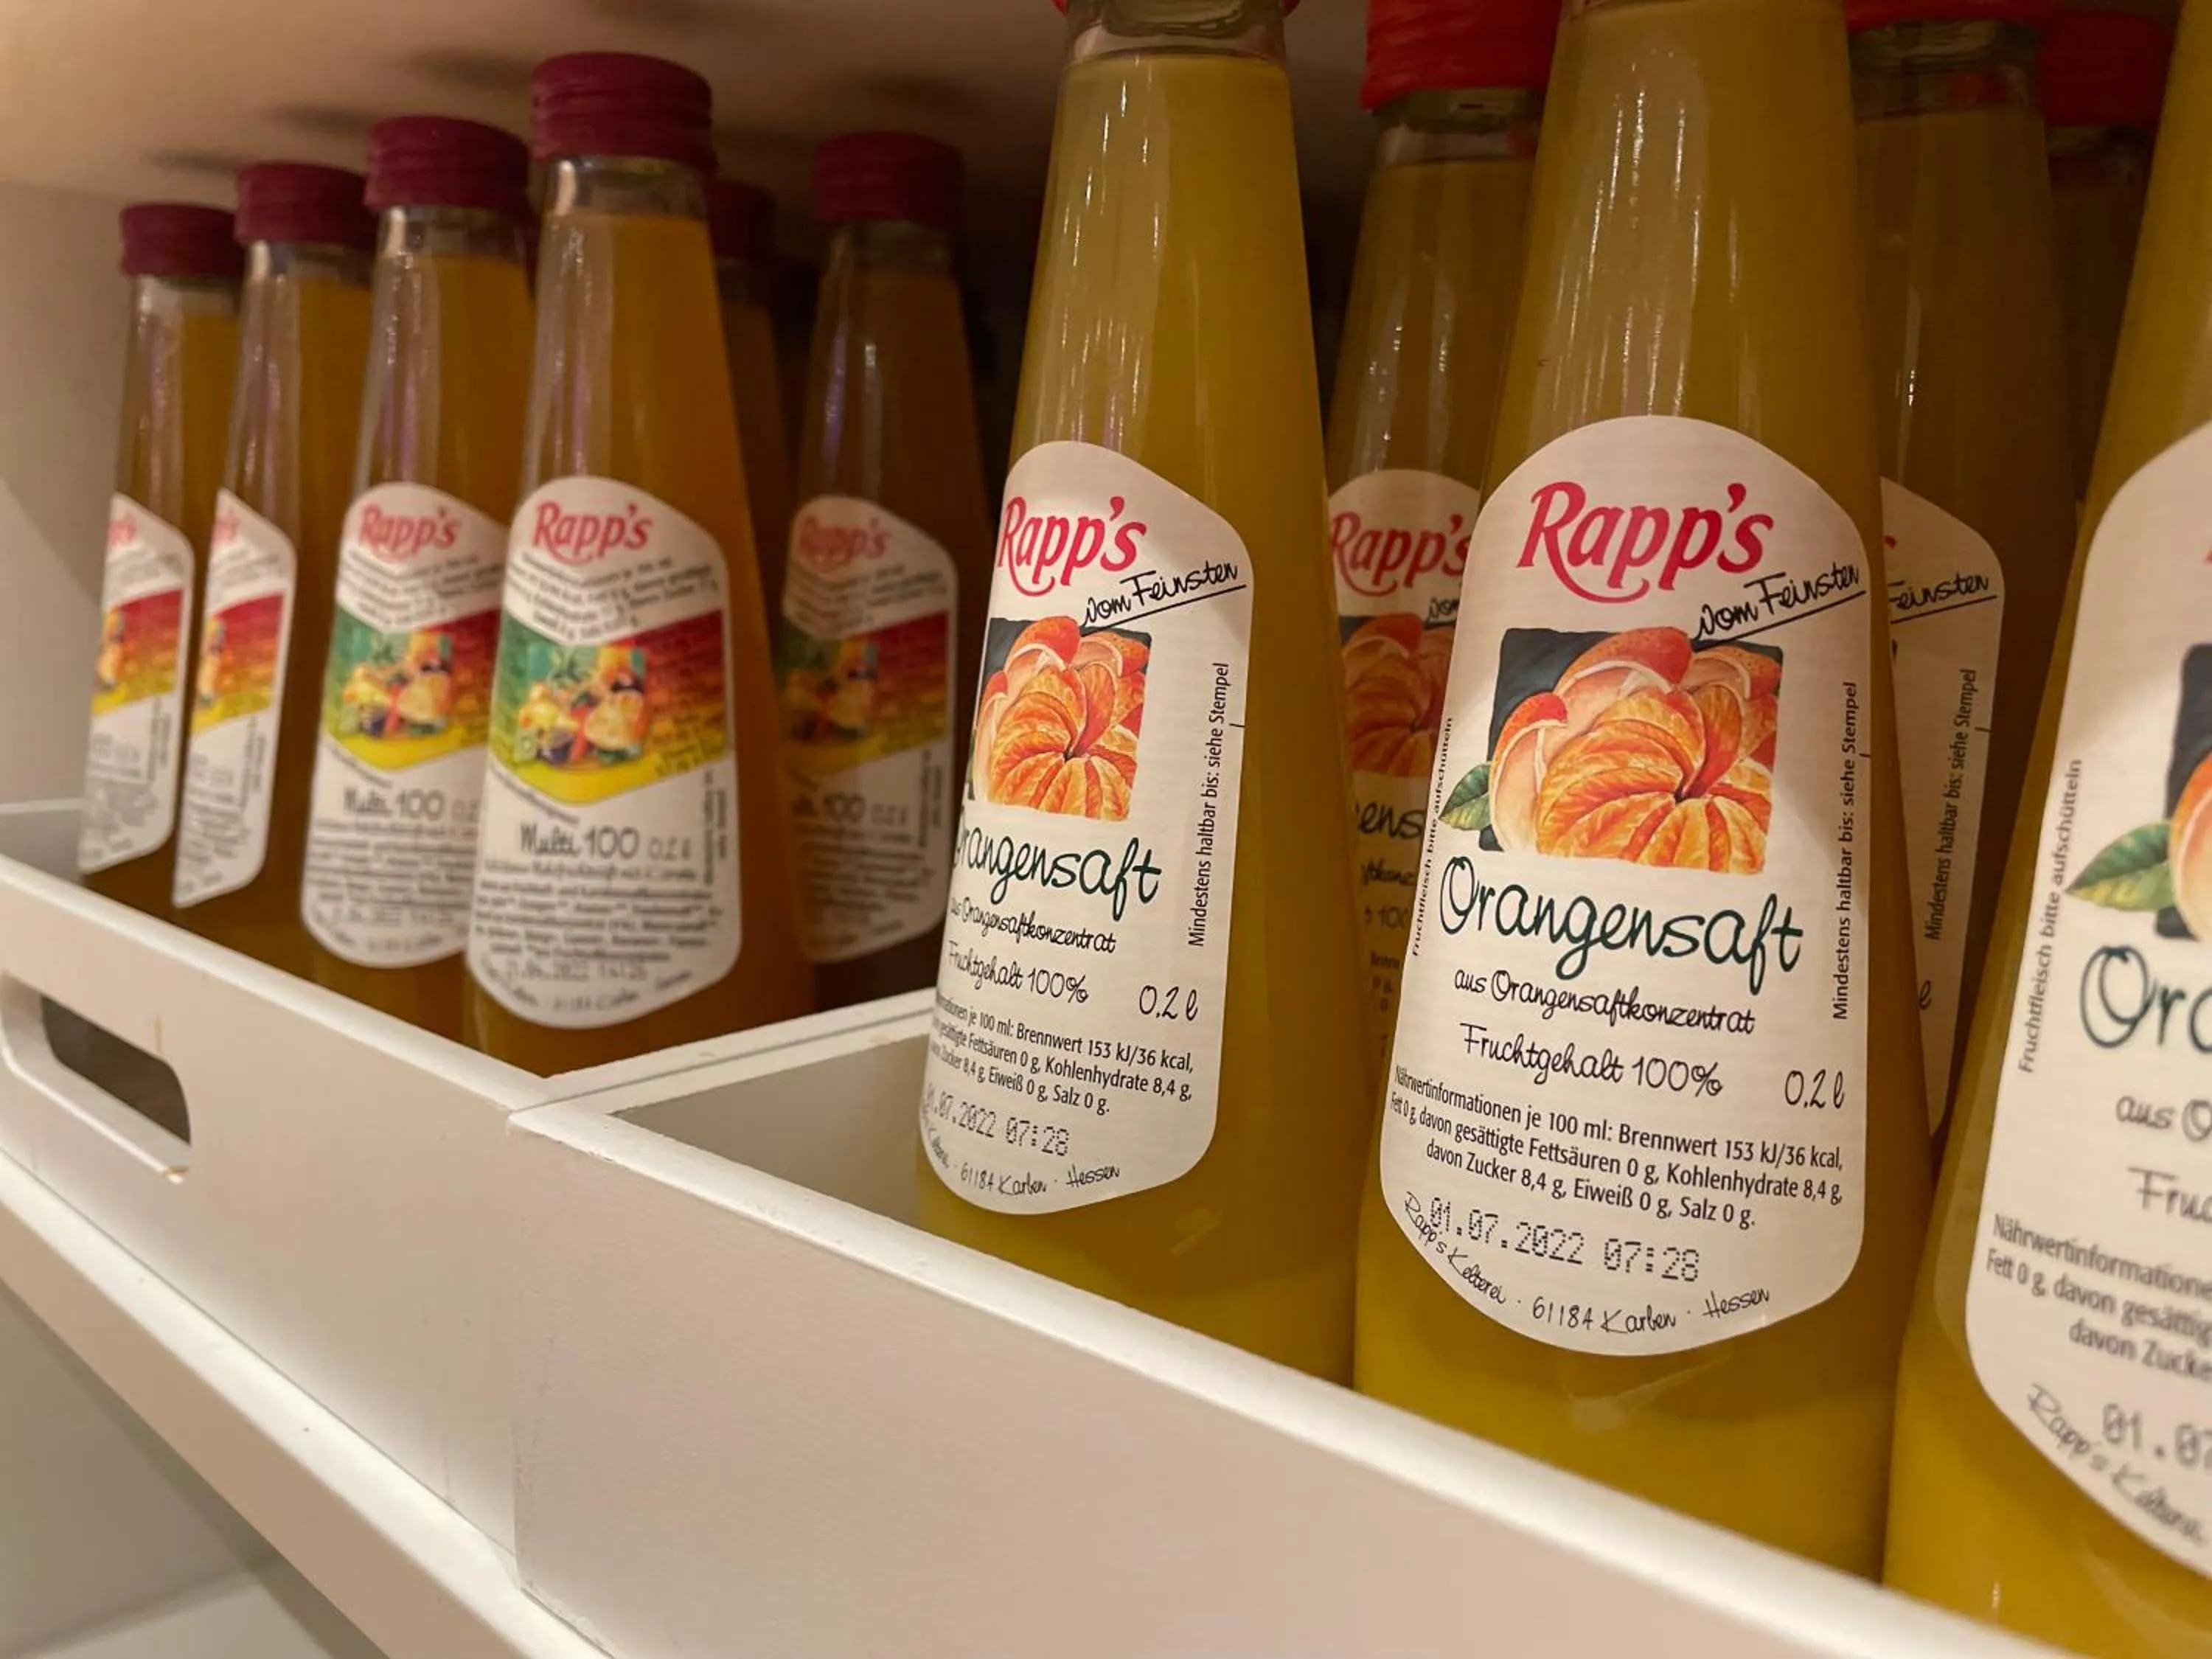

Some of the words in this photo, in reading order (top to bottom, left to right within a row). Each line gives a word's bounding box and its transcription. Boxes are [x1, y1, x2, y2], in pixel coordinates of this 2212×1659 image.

[532, 501, 653, 566] Rapp's
[998, 496, 1147, 597] Rapp's
[1332, 511, 1472, 597] Rapp's
[1516, 481, 1774, 603] Rapp's
[1080, 594, 1133, 627] vom
[1119, 561, 1237, 607] Feinsten
[1694, 605, 1759, 641] vom
[1743, 562, 1860, 616] Feinsten
[1208, 663, 1231, 725] Stempel
[1841, 682, 1860, 755] Stempel
[1954, 668, 1979, 728] Stempel
[1206, 727, 1223, 768] siehe
[1950, 729, 1969, 771] siehe
[1200, 771, 1219, 797] bis:
[1840, 759, 1857, 807] siehe
[1941, 771, 1963, 800] bis:
[1197, 802, 1216, 856] haltbar
[1837, 811, 1854, 843] bis:
[1935, 801, 1959, 855] haltbar
[1188, 860, 1211, 947] Mindestens
[1836, 847, 1853, 913] haltbar
[1924, 858, 1952, 941] Mindestens
[1439, 856, 1804, 995] Orangensaft
[2018, 943, 2053, 1074] Fruchtfleisch
[2039, 892, 2061, 938] bitte
[2053, 759, 2083, 886] aufschütteln
[1028, 967, 1089, 1004] 100%
[1454, 967, 1487, 994] aus
[1490, 969, 1756, 1034] Orangensaftkonzentrat
[1832, 917, 1851, 1020] Mindestens
[969, 1032, 1017, 1064] Fettsäuren
[1045, 1055, 1149, 1091] Kohlenhydrate
[1152, 1077, 1175, 1096] 8,4
[1179, 1084, 1193, 1102] g,
[980, 1011, 995, 1032] 100
[997, 1018, 1014, 1037] ml:
[1017, 1023, 1082, 1054] Brennwert
[1088, 1040, 1112, 1058] 153
[1116, 1042, 1156, 1067] kJ/36
[1160, 1049, 1194, 1074] kcal,
[1460, 1022, 1625, 1085] Fruchtgehalt
[1632, 1055, 1724, 1098] 100%
[989, 1066, 1023, 1092] Eiweiß
[1053, 1085, 1081, 1107] Salz
[1096, 1097, 1110, 1116] g.
[1394, 1064, 1521, 1124] Nährwertinformationen
[1524, 1105, 1541, 1131] je
[1549, 1112, 1578, 1135] 100
[1584, 1119, 1613, 1141] ml:
[1618, 1123, 1718, 1158] Brennwert
[1725, 1140, 1753, 1161] 153
[1760, 1141, 1806, 1169] kJ/36
[1810, 1145, 1843, 1172] kcal,
[2115, 1094, 2177, 1130] aus
[1006, 1116, 1070, 1157] 07:28
[1419, 1105, 1452, 1135] davon
[1455, 1122, 1525, 1156] gesättigte
[1528, 1138, 1621, 1175] Fettsäuren
[1627, 1158, 1638, 1178] 0
[1643, 1164, 1659, 1186] g,
[1666, 1163, 1798, 1198] Kohlenhydrate
[1803, 1179, 1826, 1202] 8,4
[1830, 1183, 1843, 1206] g,
[1066, 1164, 1120, 1188] Hessen
[1426, 1137, 1463, 1169] davon
[1466, 1151, 1517, 1183] Zucker
[1521, 1168, 1546, 1192] 8,4
[1551, 1178, 1567, 1200] g,
[1573, 1178, 1633, 1208] Eiweiß
[1639, 1192, 1651, 1211] 0
[1656, 1197, 1672, 1219] g,
[1679, 1197, 1717, 1221] Salz
[1722, 1203, 1733, 1223] 0
[1739, 1208, 1756, 1231] g.
[1430, 1197, 1585, 1265] 01.07.2022
[1604, 1238, 1700, 1281] 07:28
[1533, 1295, 1593, 1330] 61184
[1600, 1304, 1677, 1334] Karben
[1702, 1288, 1770, 1318] Hessen
[1986, 1248, 2014, 1280] Fett
[2017, 1262, 2028, 1285] 0
[2053, 1272, 2117, 1314] davon
[2068, 1317, 2137, 1361] davon
